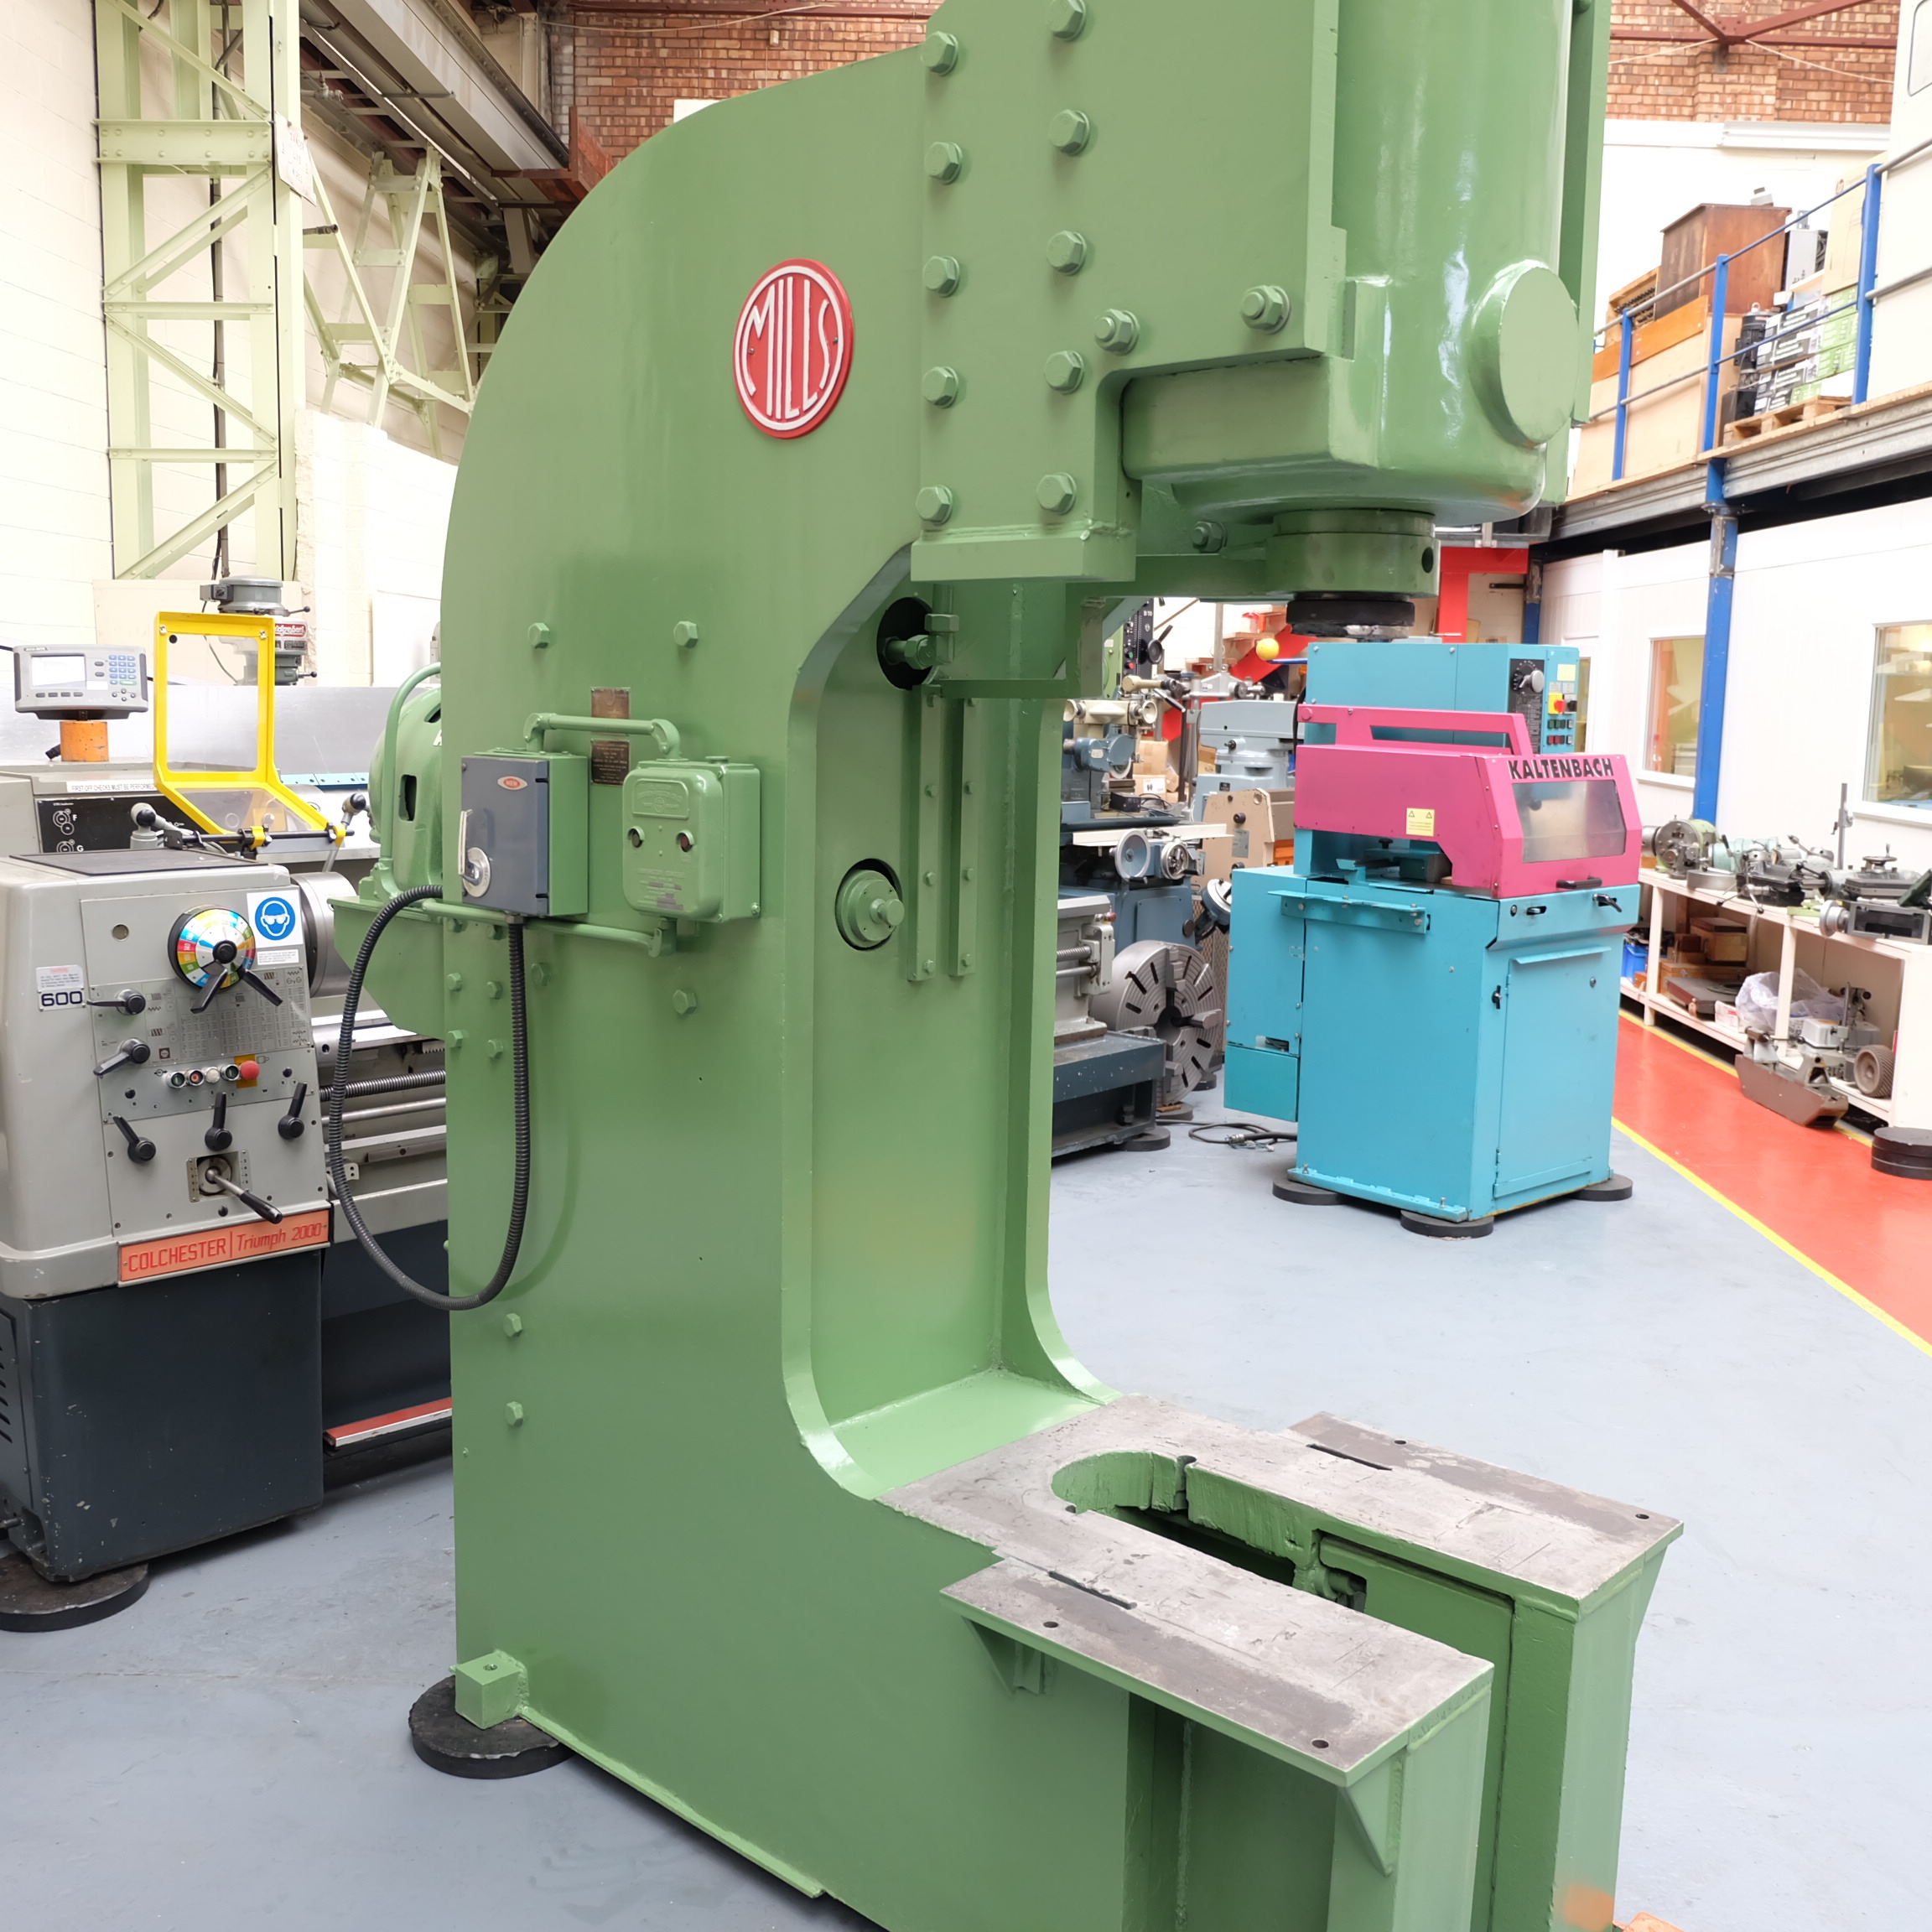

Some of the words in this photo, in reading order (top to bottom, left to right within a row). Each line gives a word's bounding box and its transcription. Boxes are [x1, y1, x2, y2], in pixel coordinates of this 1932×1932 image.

[741, 276, 830, 420] MILLS
[1508, 757, 1614, 780] KALTENBACH
[41, 990, 83, 1007] 600
[127, 1238, 226, 1273] COLCHESTER
[236, 1228, 287, 1250] Triumph
[291, 1222, 322, 1241] 2000
